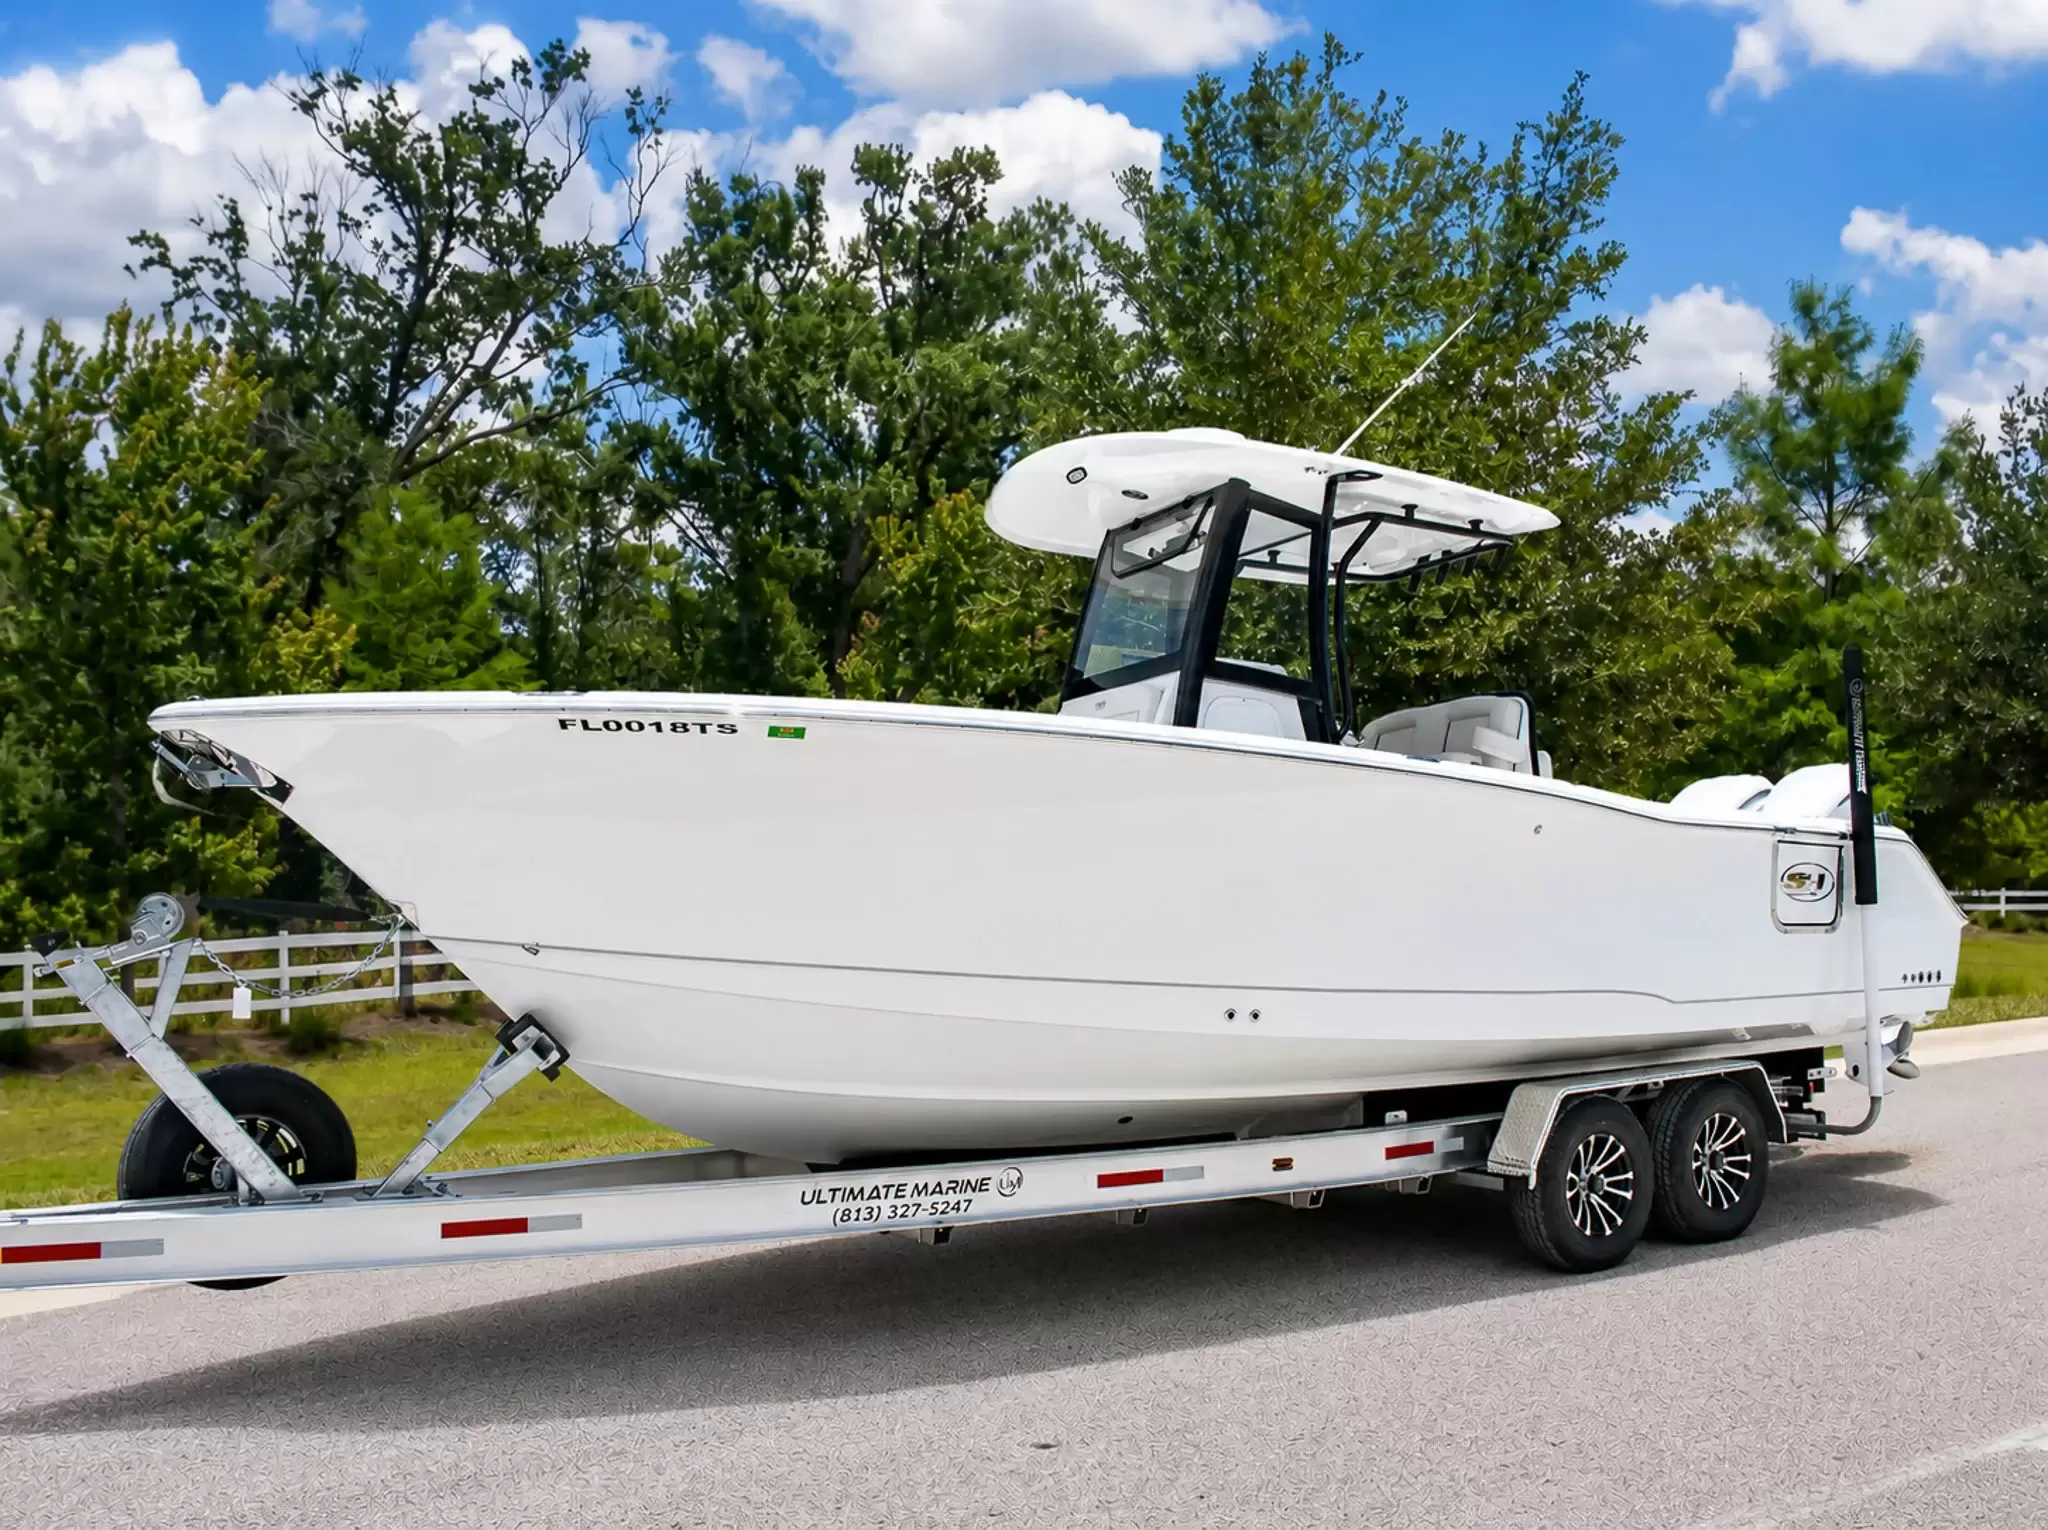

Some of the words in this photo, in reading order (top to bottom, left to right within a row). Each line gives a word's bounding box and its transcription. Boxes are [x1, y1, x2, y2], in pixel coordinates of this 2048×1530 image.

[558, 719, 738, 735] FL0018TS
[800, 1182, 908, 1205] ULTIMATE
[910, 1176, 992, 1197] MARINE
[832, 1205, 881, 1227] (813)
[887, 1199, 973, 1219] 327-5247
